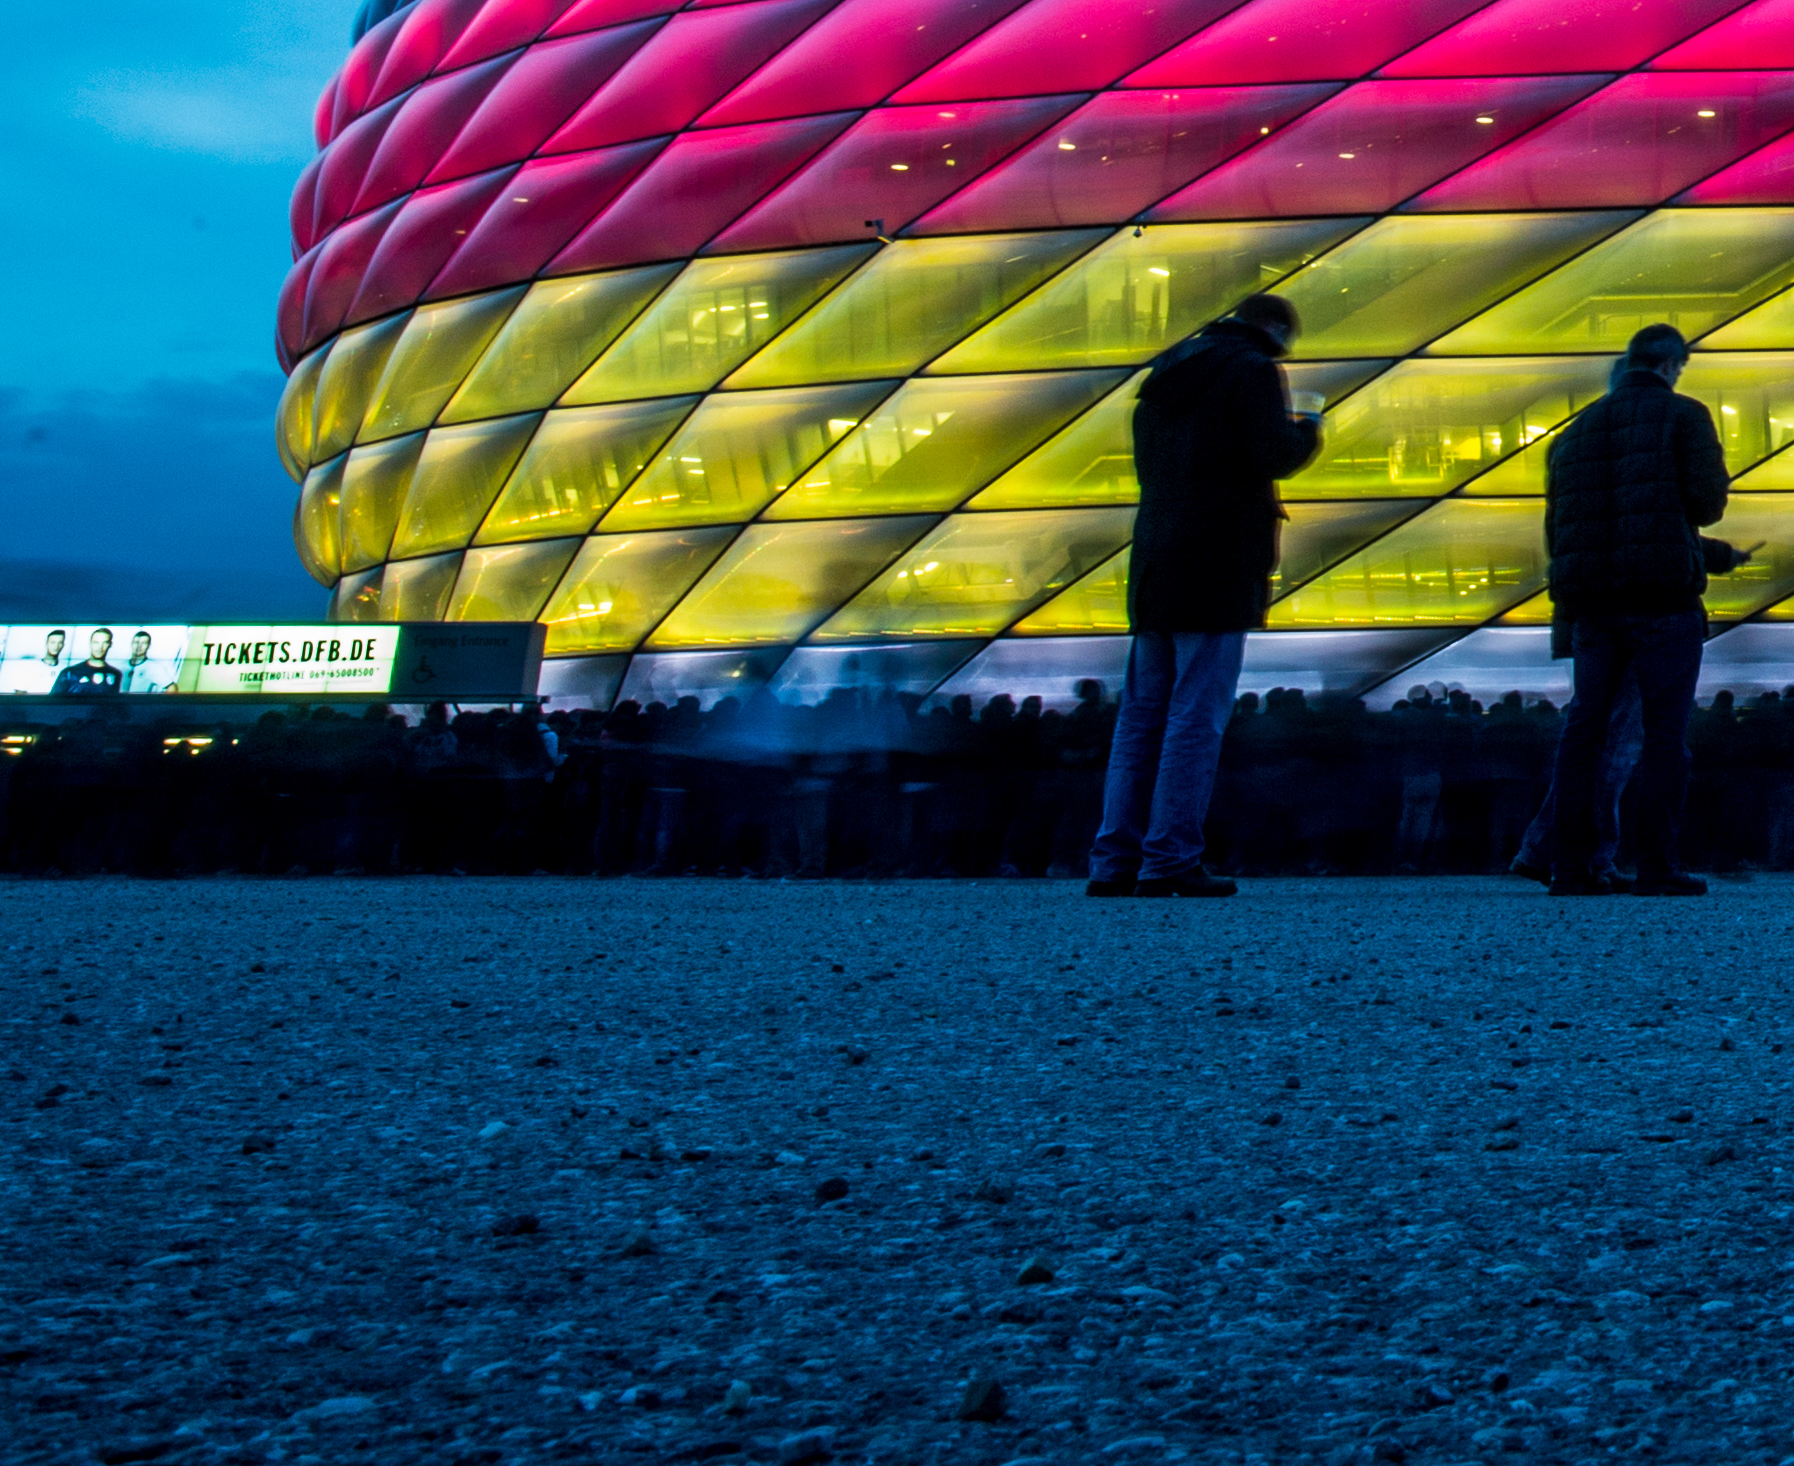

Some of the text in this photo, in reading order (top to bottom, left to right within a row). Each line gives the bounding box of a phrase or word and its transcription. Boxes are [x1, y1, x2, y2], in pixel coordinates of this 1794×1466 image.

[202, 638, 378, 666] TICKETS.DFB.DE
[414, 635, 510, 649] Eingang Entrance
